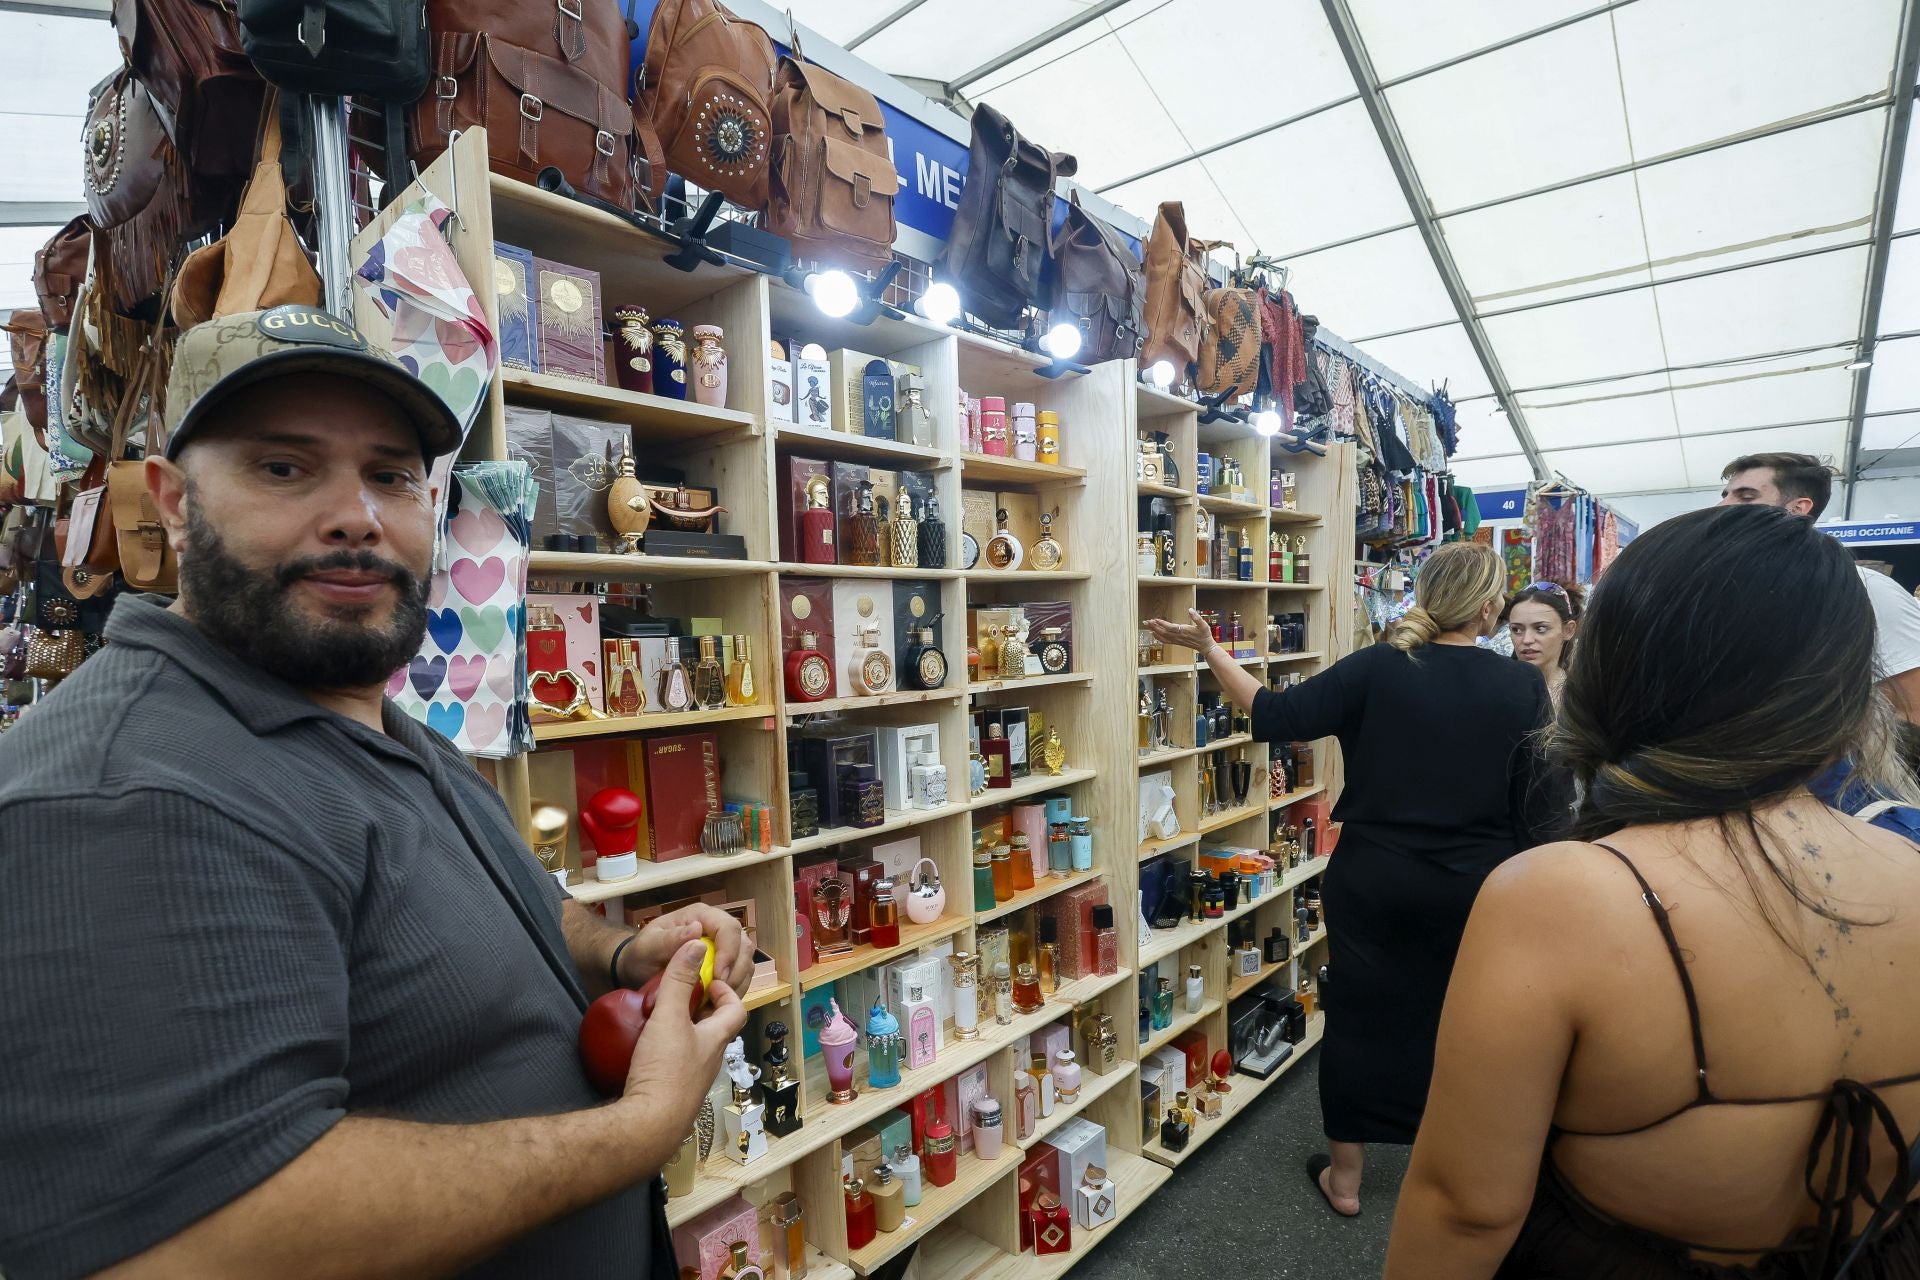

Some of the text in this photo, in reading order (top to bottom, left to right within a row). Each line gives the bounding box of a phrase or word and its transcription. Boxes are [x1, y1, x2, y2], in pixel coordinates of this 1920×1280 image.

[915, 151, 967, 211] ME
[263, 312, 360, 343] GUCCI
[1502, 500, 1515, 510] 40
[1858, 526, 1914, 537] OCCITANIE
